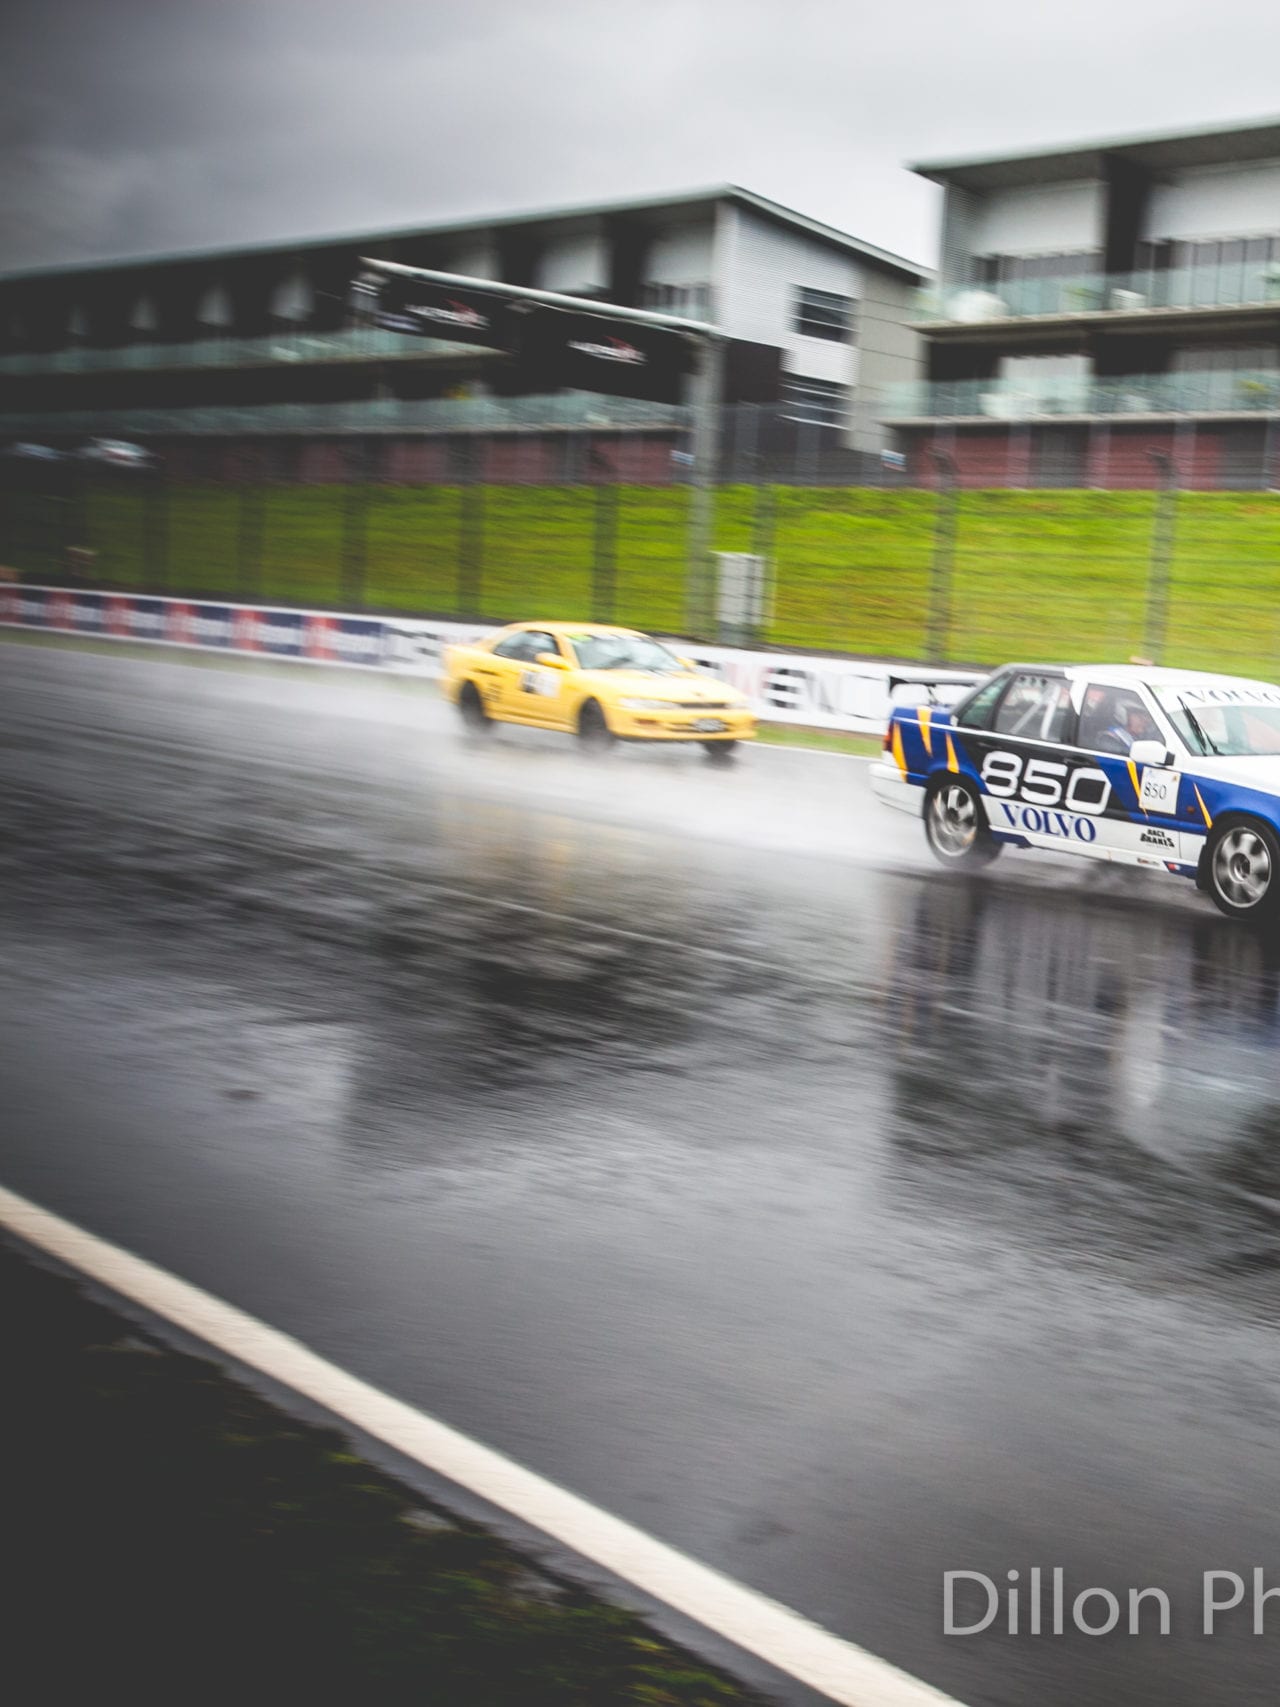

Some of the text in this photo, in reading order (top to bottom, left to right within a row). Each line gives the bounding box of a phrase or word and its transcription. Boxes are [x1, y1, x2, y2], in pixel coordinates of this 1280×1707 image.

[980, 750, 1112, 815] 850
[1143, 782, 1167, 800] 850
[1001, 803, 1096, 842] VOLVO
